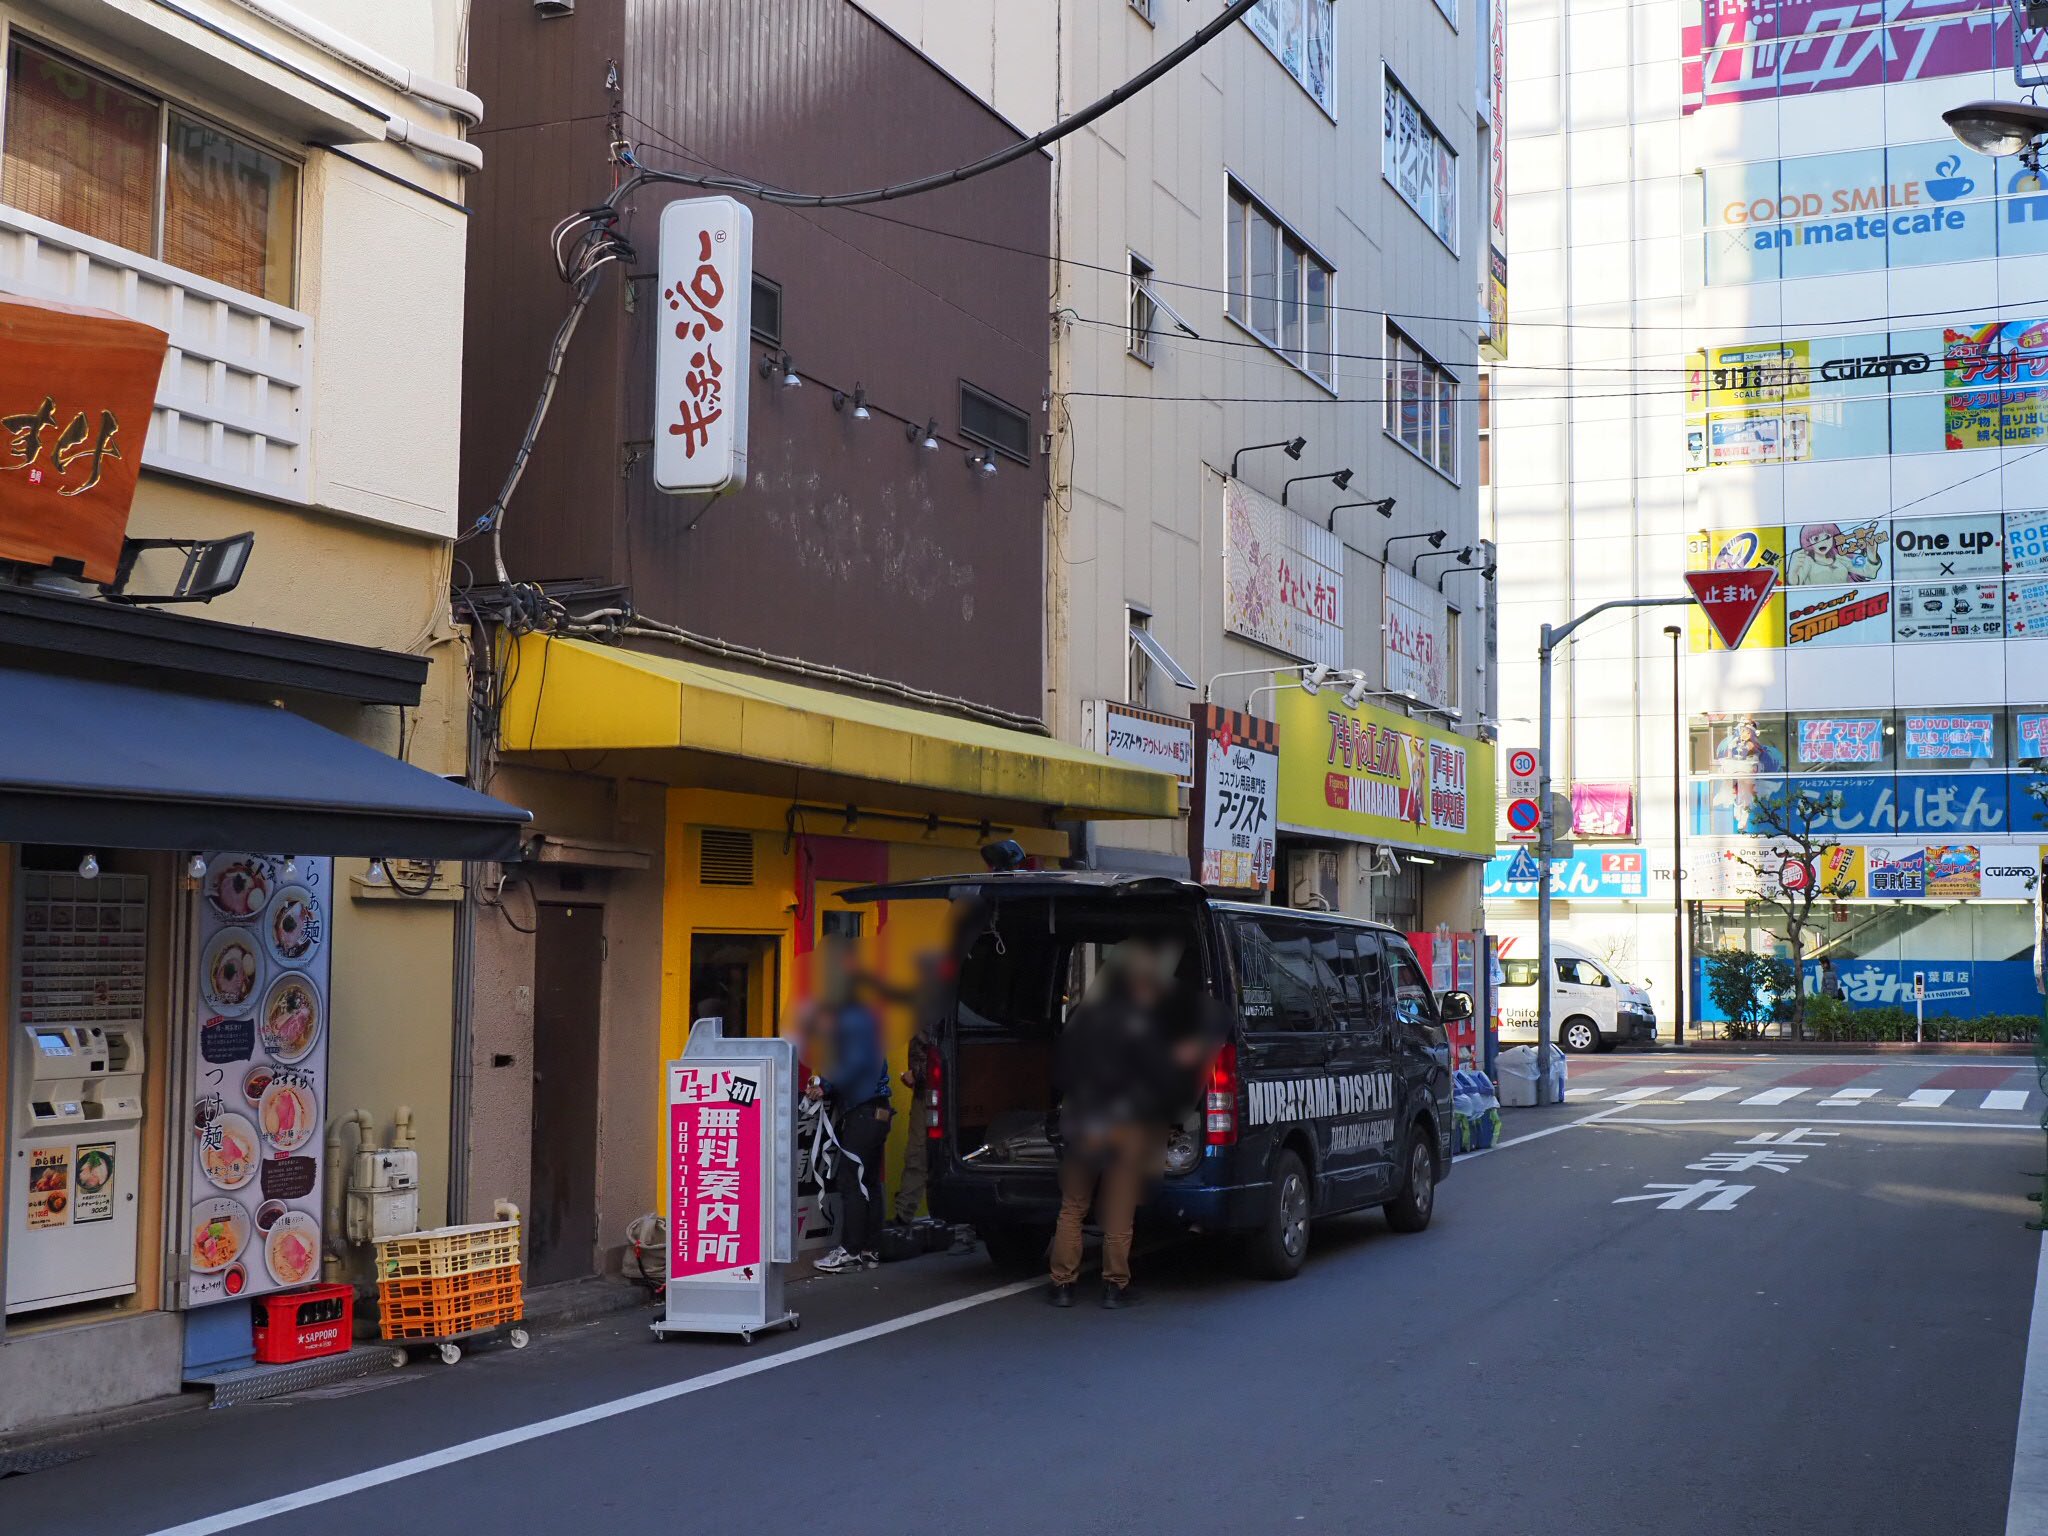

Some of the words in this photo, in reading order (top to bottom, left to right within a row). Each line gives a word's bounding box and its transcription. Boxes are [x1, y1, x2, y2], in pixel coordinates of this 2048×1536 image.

[1724, 193, 1823, 225] GOOD
[1832, 181, 1919, 215] SMILE
[1754, 216, 1886, 250] animate
[1893, 207, 1965, 236] cafe
[1896, 530, 1949, 551] One
[1960, 531, 2000, 554] up.
[1703, 584, 1757, 604] 止まれ
[1983, 622, 2001, 632] CCP
[1109, 729, 1135, 751] アシスト
[1908, 719, 1923, 729] CD
[1927, 718, 1949, 729] DVD
[1430, 744, 1465, 790] アキバ
[1516, 758, 1530, 770] 30
[1919, 745, 1949, 756] コミック
[1214, 789, 1268, 834] アシスト
[1348, 776, 1400, 819] AKIHABARA
[1431, 787, 1465, 829] 中央店
[1796, 786, 2003, 828] らしんばん
[1253, 837, 1273, 883] 4F
[1609, 855, 1635, 871] 2F
[302, 860, 320, 944] らぁ麺
[1507, 1018, 1539, 1028] Renta
[675, 1069, 731, 1101] アキバ
[731, 1081, 754, 1103] 初
[1248, 1079, 1338, 1126] MURAYAMA
[1339, 1072, 1393, 1115] DISPLAY
[203, 1068, 224, 1151] つけ麺
[696, 1107, 741, 1264] 無料案内所
[1612, 1127, 1840, 1210] 止まれ
[305, 1328, 338, 1342] SAPPORO
